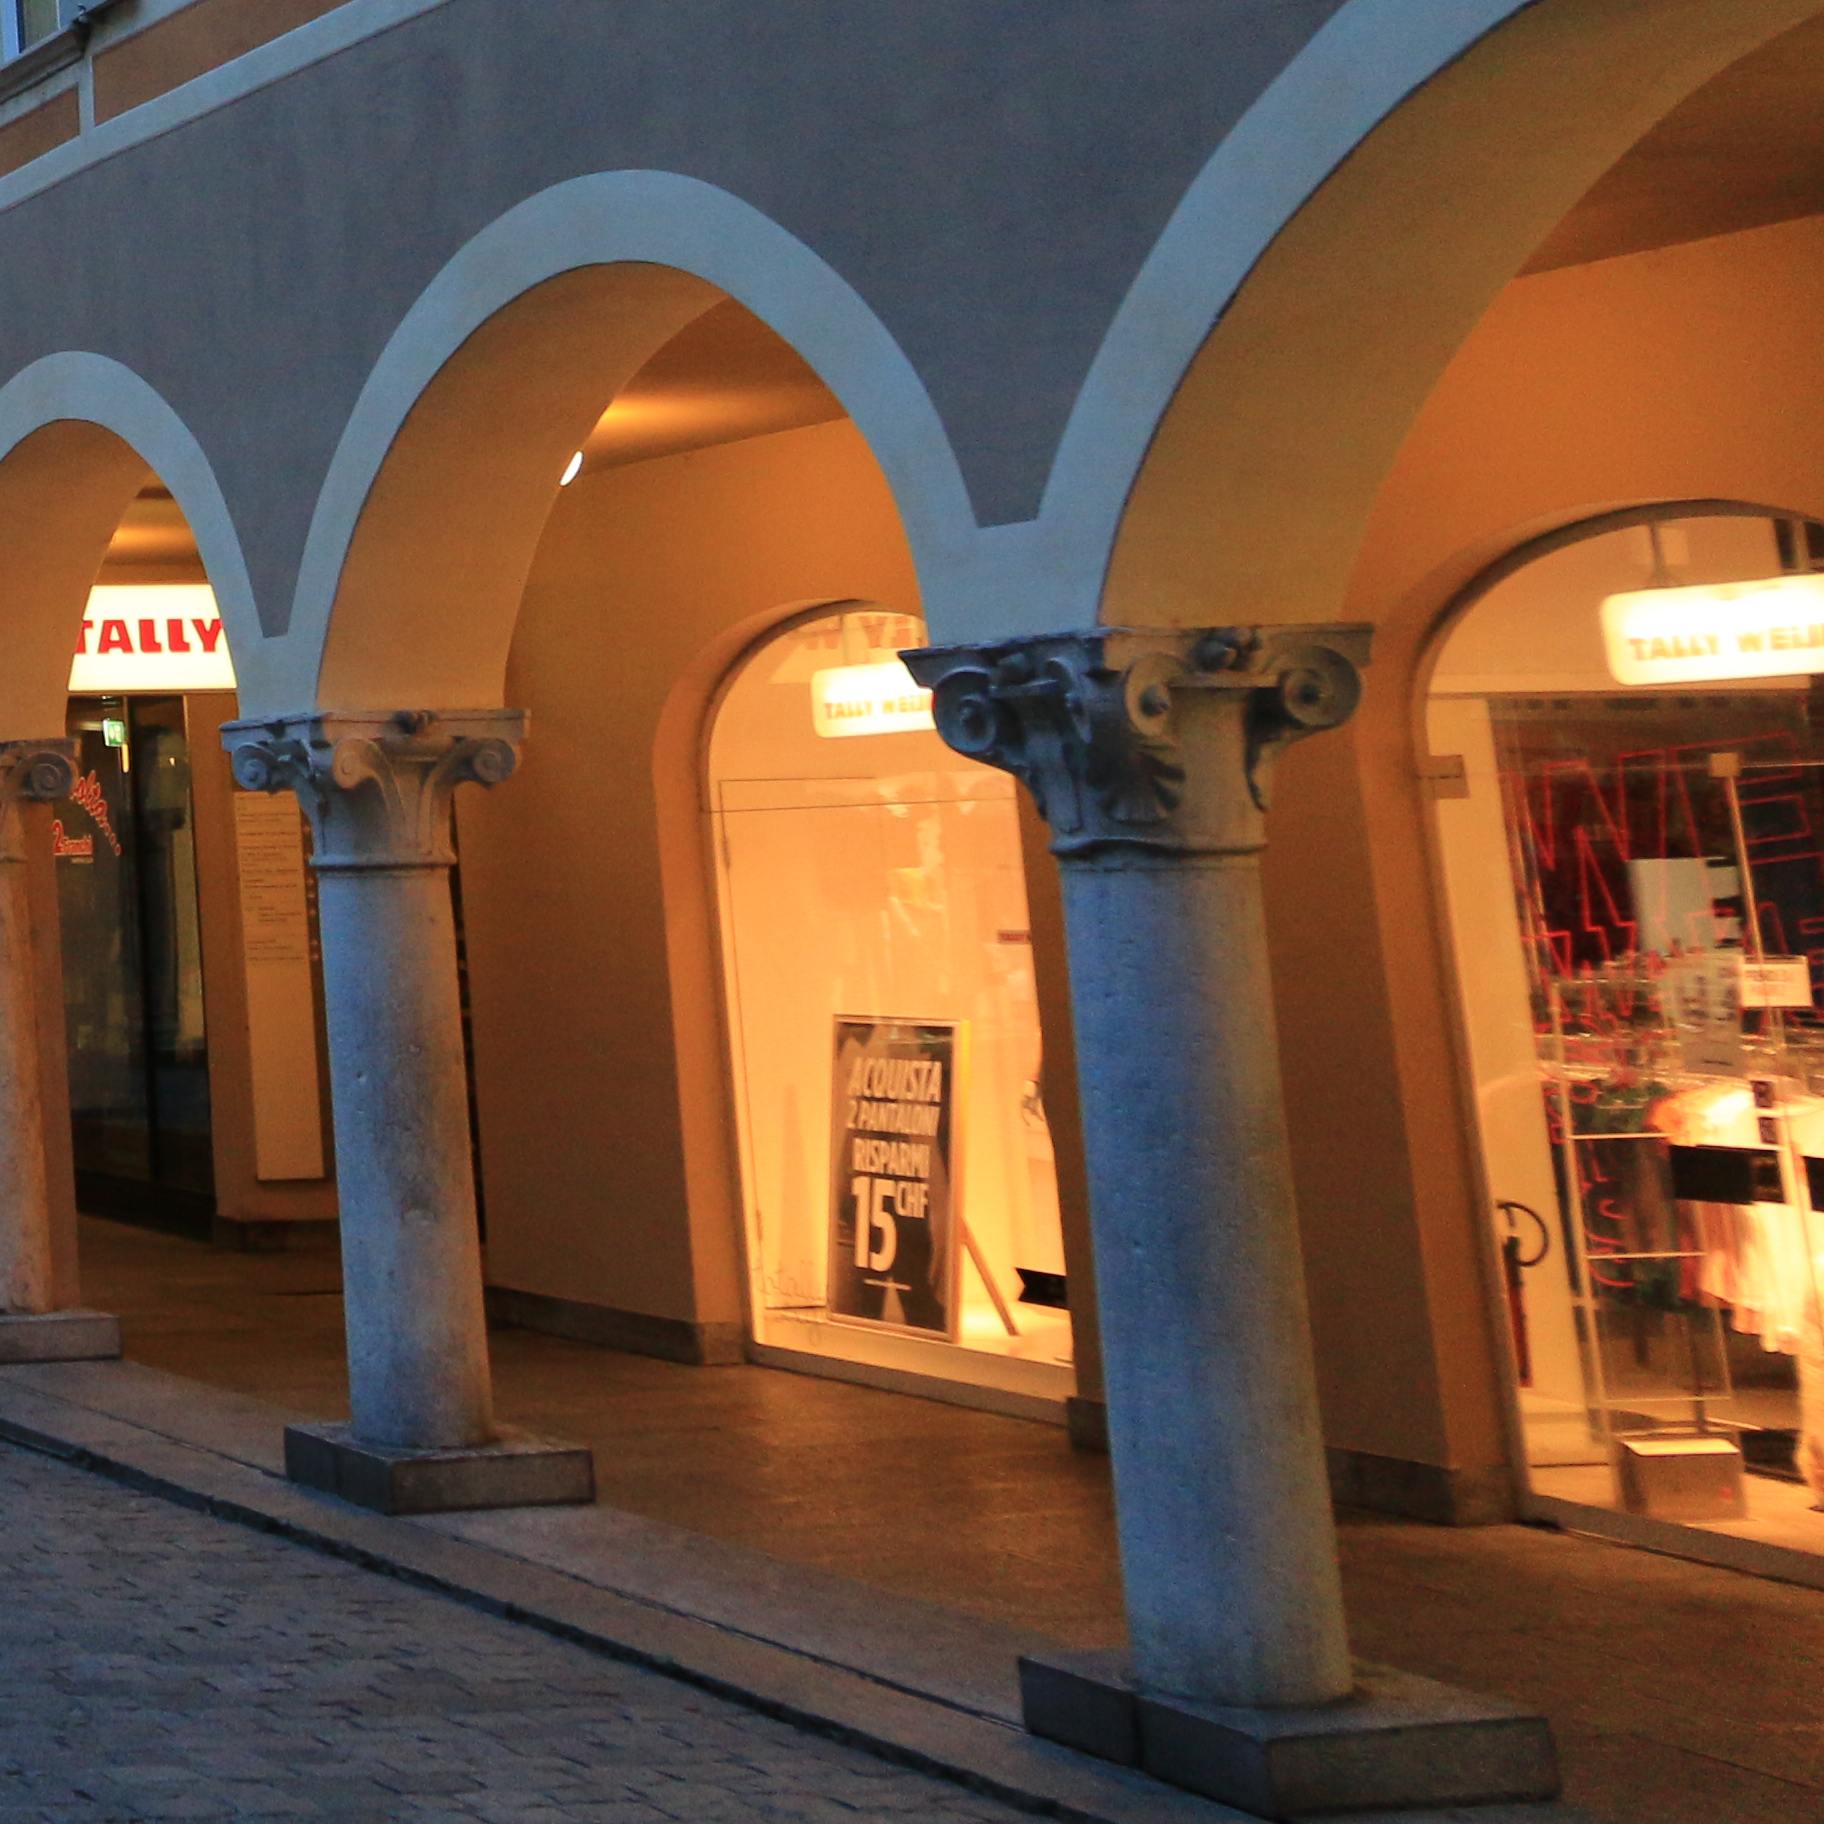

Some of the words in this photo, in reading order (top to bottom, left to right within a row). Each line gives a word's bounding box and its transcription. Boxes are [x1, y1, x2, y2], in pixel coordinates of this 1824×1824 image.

[76, 618, 224, 654] TALLY
[1628, 634, 1719, 662] TALLY
[824, 699, 873, 720] TALLY
[848, 1056, 943, 1103] ACQUISTA
[858, 1100, 940, 1137] PANTALONI
[853, 1136, 930, 1179] RISPARMI
[852, 1175, 897, 1273] 15
[896, 1178, 929, 1219] CHF
